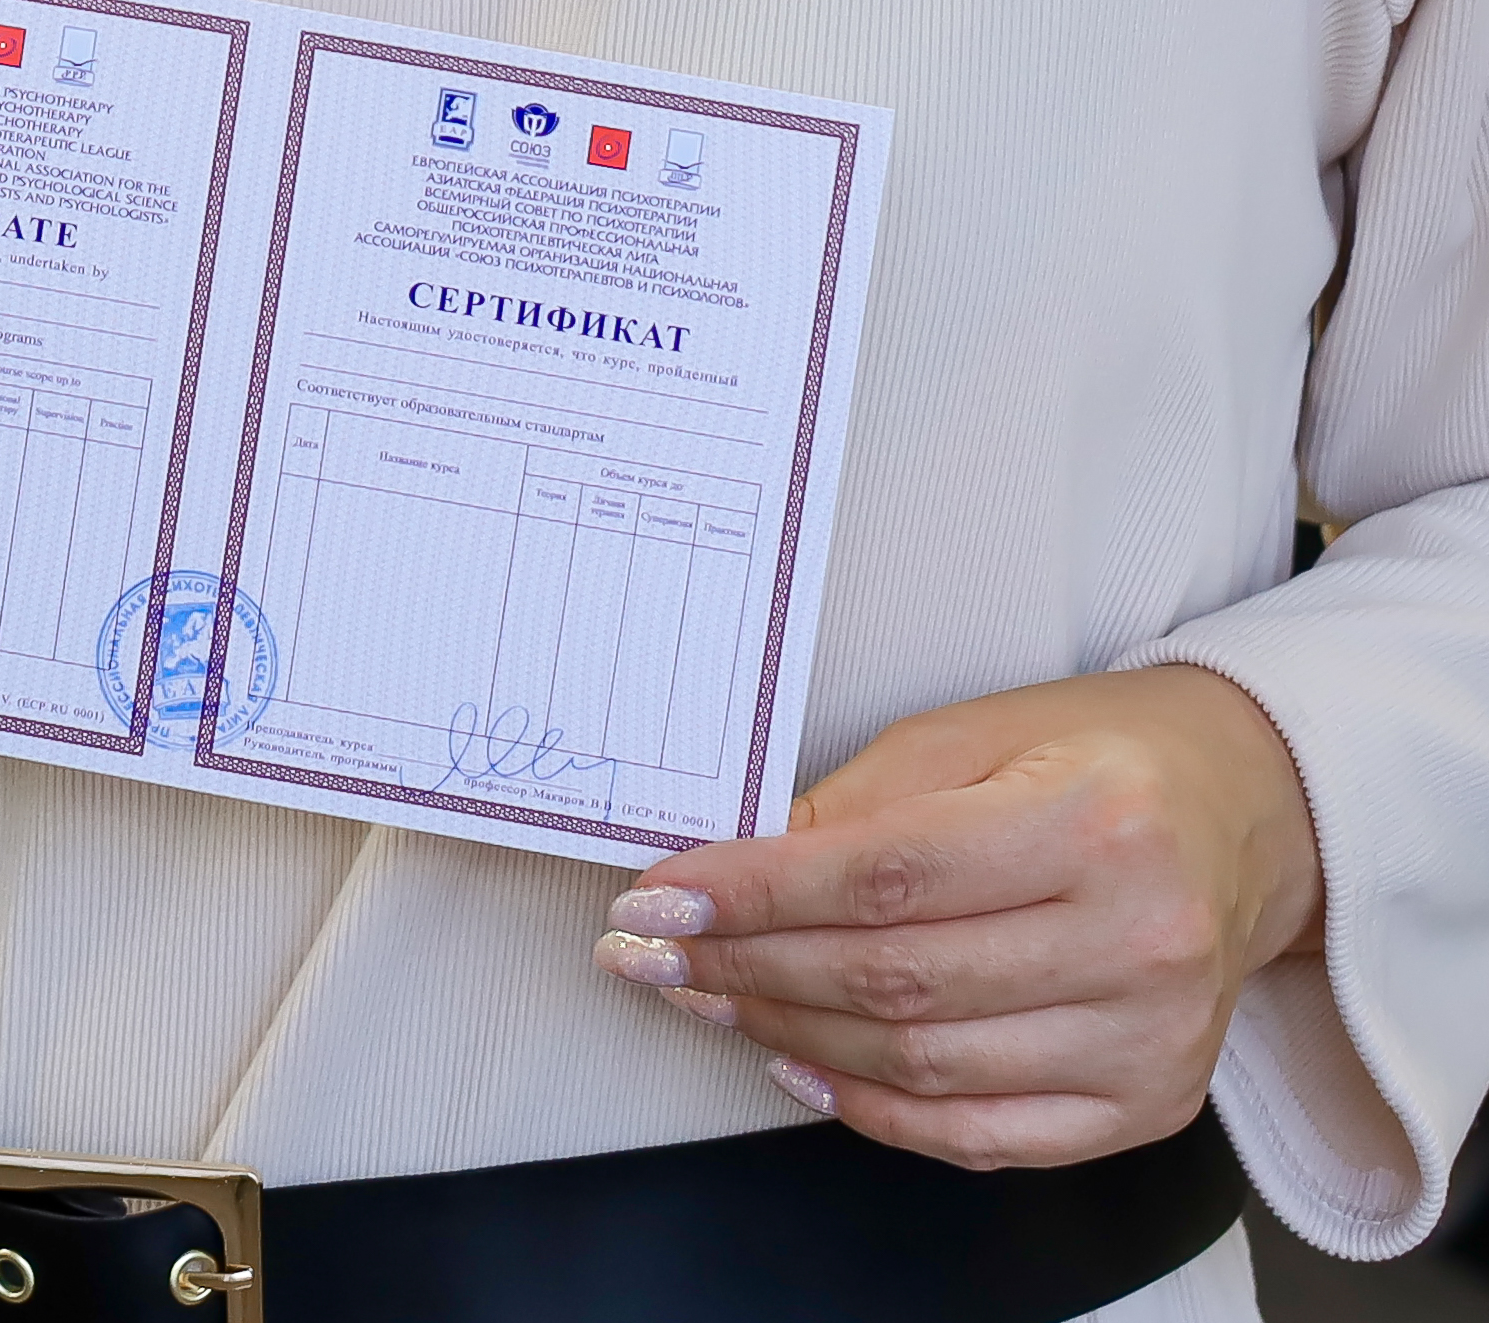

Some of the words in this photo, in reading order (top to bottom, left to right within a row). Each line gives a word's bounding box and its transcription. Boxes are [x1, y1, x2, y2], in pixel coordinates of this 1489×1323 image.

[2, 86, 114, 114] PSYCHOTHERAPY
[79, 141, 131, 161] LEAGUE
[509, 139, 552, 158] СОЮЗ
[11, 174, 121, 203] PSYCHOLOGICAL
[125, 193, 178, 212] SCIENCE
[24, 162, 115, 187] ASSOCIATION
[117, 177, 143, 192] FOR
[146, 182, 170, 197] THE
[411, 154, 508, 181] ЕВРОПЕЙСКАЯ
[509, 172, 608, 198] АССОЦИАЦИЯ
[610, 188, 721, 218] ПСИХОТЕРАПИИ
[23, 191, 55, 206] AND
[423, 185, 511, 211] ВСЕМИРНЫЙ
[514, 201, 558, 219] СОВЕТ
[560, 208, 583, 223] ПО
[585, 213, 696, 243] ПСИХОТЕРАПИИ
[425, 172, 501, 195] АЗИАТСКАЯ
[504, 186, 585, 209] ФЕДЕРАЦИЯ
[587, 199, 698, 229] ПСИХОТЕРАПИИ
[416, 198, 545, 231] ОБЩЕРОССИЙСКАЯ
[548, 221, 699, 258] ПРОФЕССИОНАЛЬНАЯ
[451, 219, 622, 259] ПСИХОТЕРАПЕВТИЧЕСКАЯ
[624, 250, 660, 265] ЛИГА
[9, 253, 85, 275] undertaken
[91, 264, 109, 282] by
[353, 231, 450, 258] АССОЦИАЦИЯ
[504, 257, 634, 290] ПСИХОТЕРАПЕВТОВ
[636, 280, 648, 293] И
[373, 220, 516, 255] САМОРЕГУЛИРУЕМАЯ
[518, 245, 618, 273] ОРГАНИЗАЦИЯ
[621, 263, 738, 293] НАЦИОНАЛЬНАЯ
[407, 281, 690, 352] СЕРТИФИКАТ
[357, 309, 441, 336] Настоящим
[446, 328, 564, 359] удостоверяется,
[571, 349, 596, 362] что
[602, 355, 640, 372] курс,
[647, 363, 738, 387] пройденный
[25, 370, 53, 384] scope
[69, 376, 81, 387] to
[296, 378, 398, 407] Соответствует
[399, 397, 521, 429] образовательным
[524, 421, 605, 443] стандартам
[430, 462, 460, 475] курса
[636, 476, 668, 488] курса
[49, 702, 68, 715] RU
[72, 707, 105, 724] 0001)
[243, 718, 334, 745] Преподаватель
[339, 739, 373, 752] курса
[242, 736, 325, 760] Руководитель
[329, 754, 397, 773] программы
[461, 771, 527, 798] профессор
[532, 786, 585, 806] Макаров
[657, 809, 677, 822] RU
[681, 814, 716, 832] 0001)
